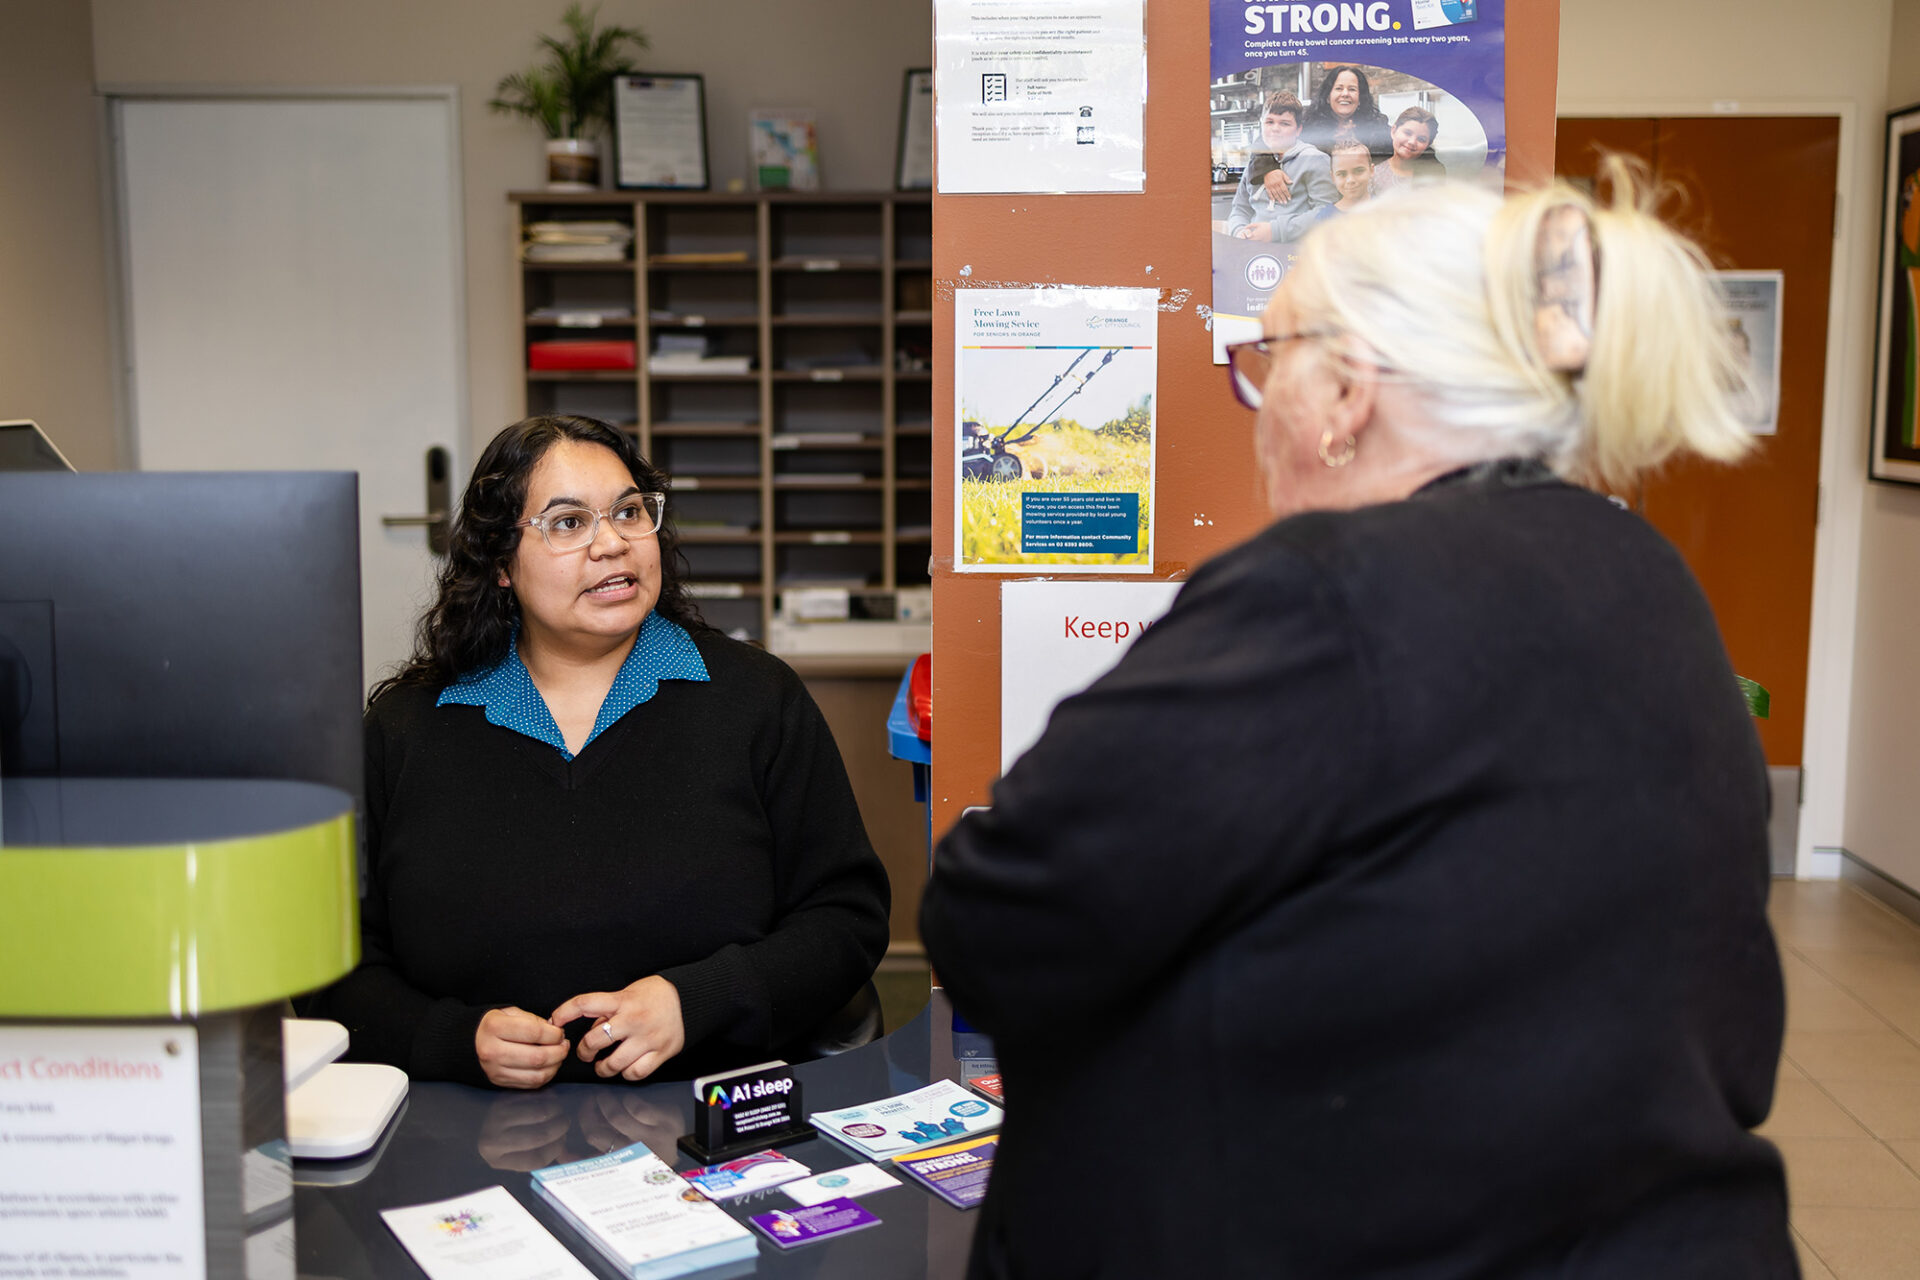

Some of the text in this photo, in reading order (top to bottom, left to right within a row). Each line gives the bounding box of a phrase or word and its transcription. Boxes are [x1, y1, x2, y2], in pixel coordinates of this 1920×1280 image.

[1244, 2, 1401, 34] STRONG.
[1244, 40, 1280, 49] Complete
[1356, 37, 1392, 45] screening
[974, 308, 1020, 317] Free Lawn
[974, 320, 1010, 330] Mowing
[1065, 616, 1130, 644] Keep
[30, 1056, 163, 1080] Conditions
[753, 1078, 793, 1097] sleep
[915, 1154, 983, 1174] STRONG.
